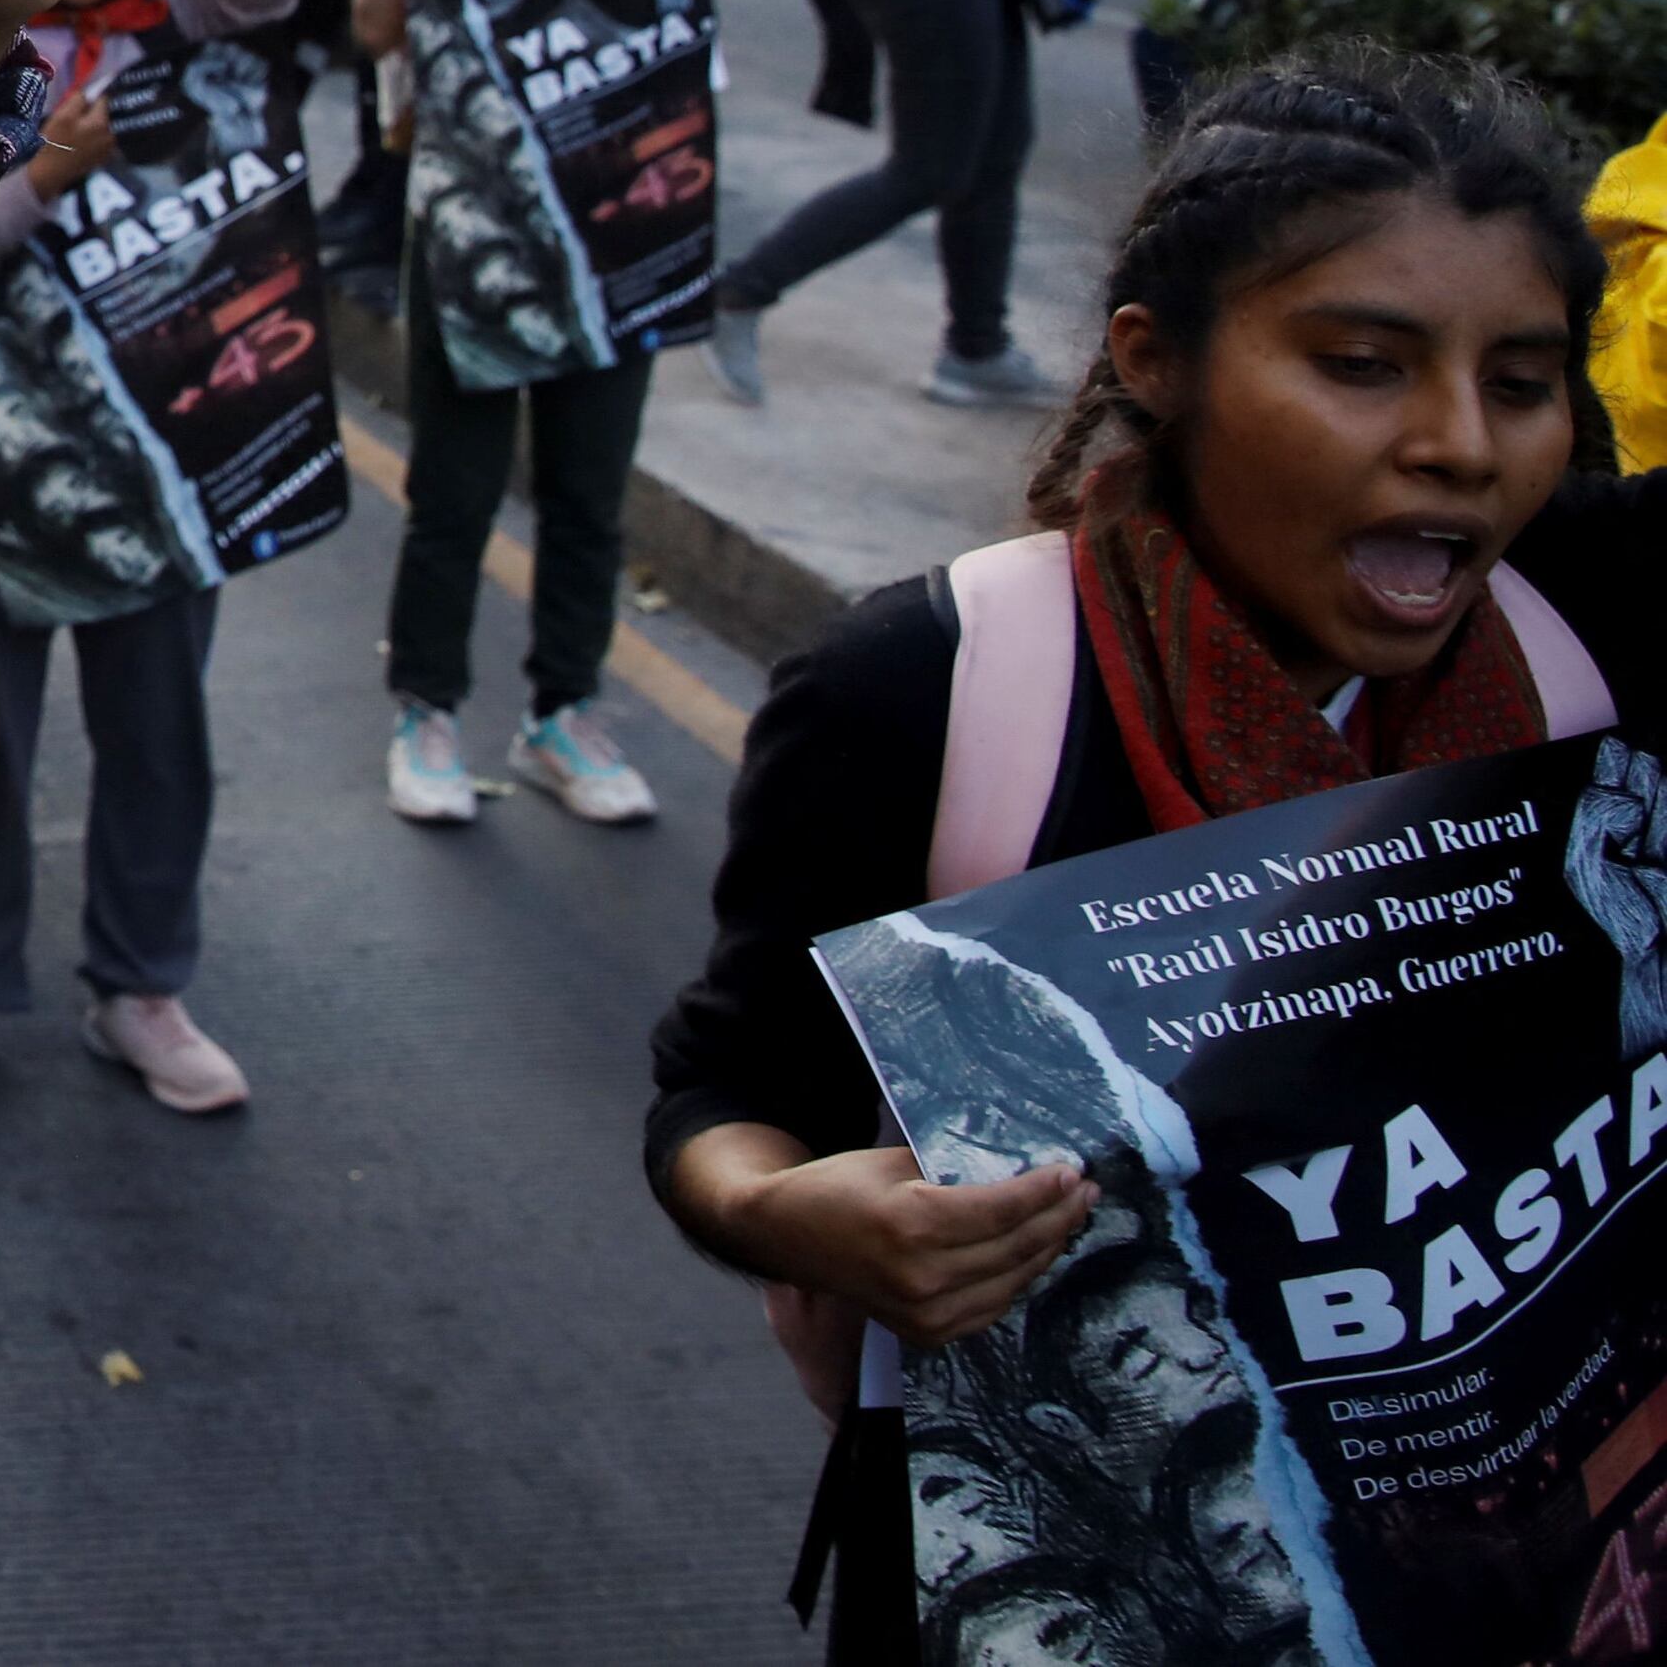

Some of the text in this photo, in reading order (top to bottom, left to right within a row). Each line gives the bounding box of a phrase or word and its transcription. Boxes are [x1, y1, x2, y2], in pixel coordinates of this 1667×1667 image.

[505, 17, 588, 70] YA
[53, 170, 135, 237] YA
[1079, 800, 1541, 935] Escuela Normal Rural
[1107, 867, 1522, 989] "Raúl Isidro Burgos"
[1146, 930, 1565, 1053] Ayotzinapa, Guerrero.
[1240, 1104, 1468, 1243] YA
[1279, 1052, 1667, 1363] BASTA
[1328, 1367, 1496, 1422] De simular.
[1339, 1410, 1500, 1461] De mentir.
[1353, 1337, 1616, 1501] De desvirtuar la verdad.
